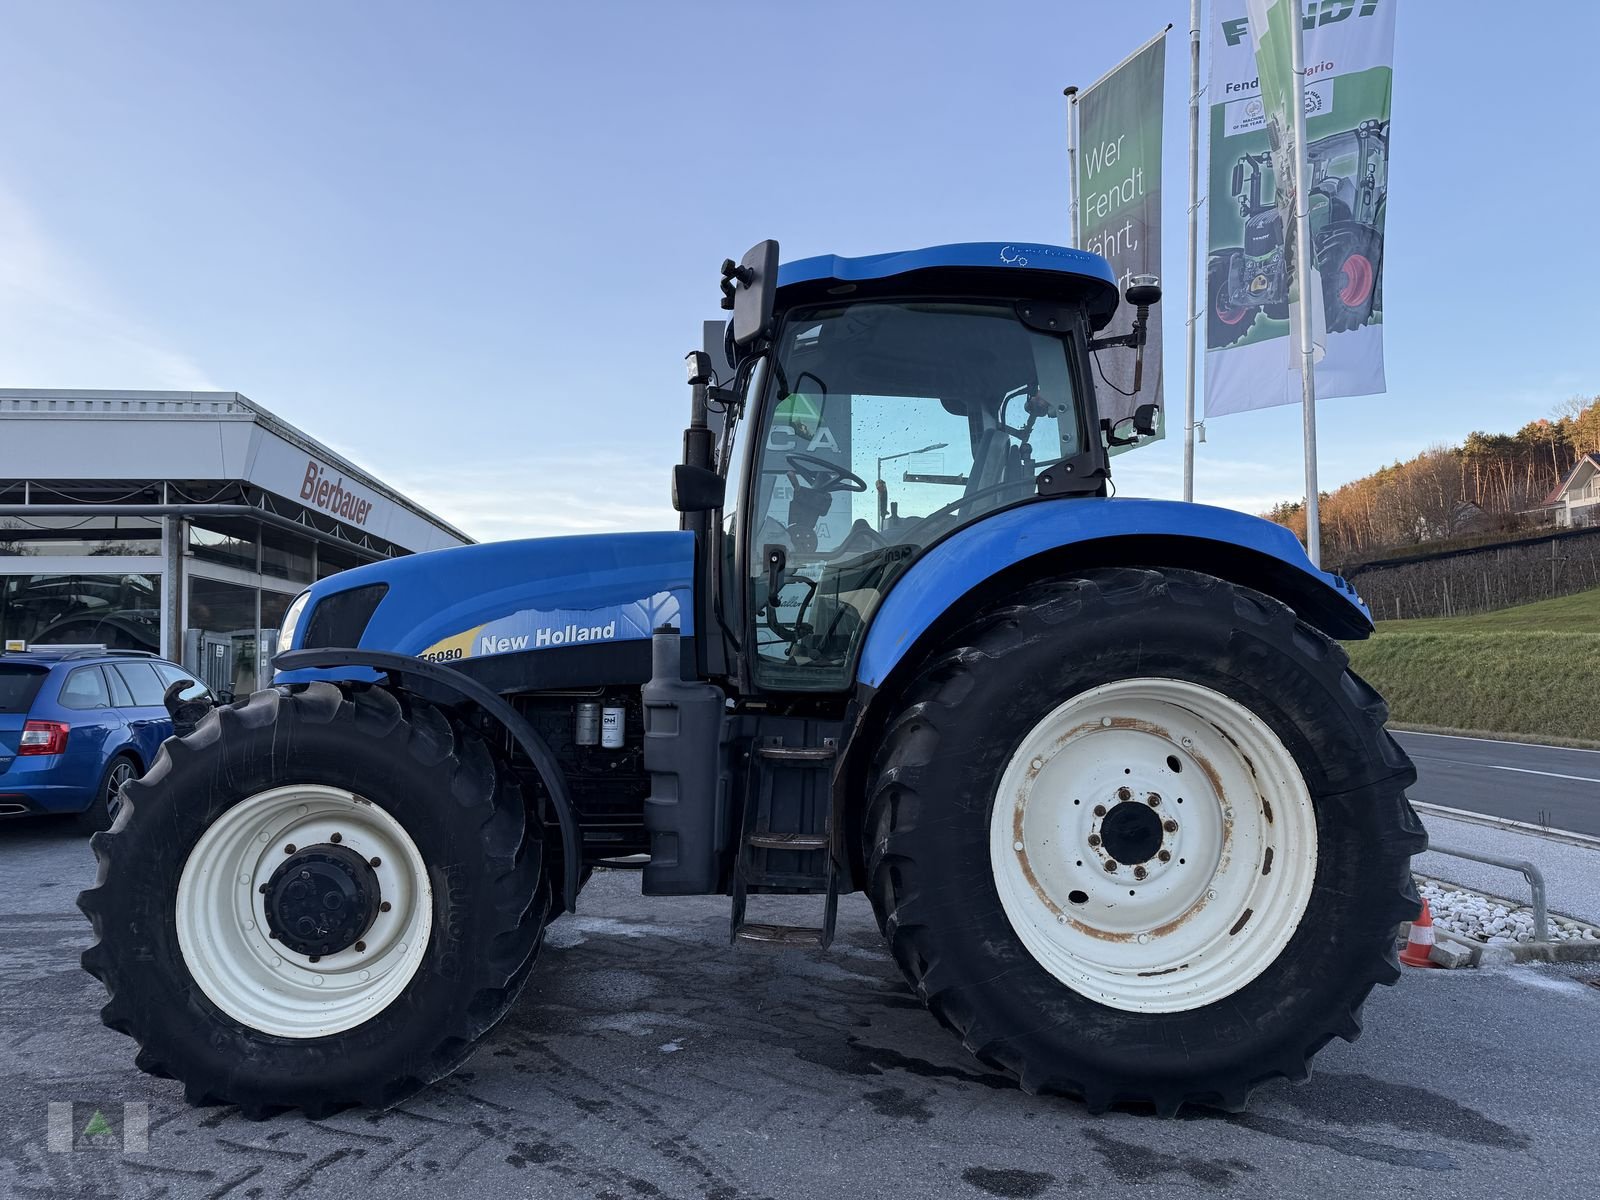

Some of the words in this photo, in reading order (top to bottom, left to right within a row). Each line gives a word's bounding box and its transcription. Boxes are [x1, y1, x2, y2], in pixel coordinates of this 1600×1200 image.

[1226, 78, 1259, 93] Fend
[1086, 134, 1125, 180] Wer
[1086, 168, 1143, 226] Fendt
[300, 461, 372, 526] Bierbauer
[481, 635, 529, 655] New
[536, 621, 615, 647] Holland
